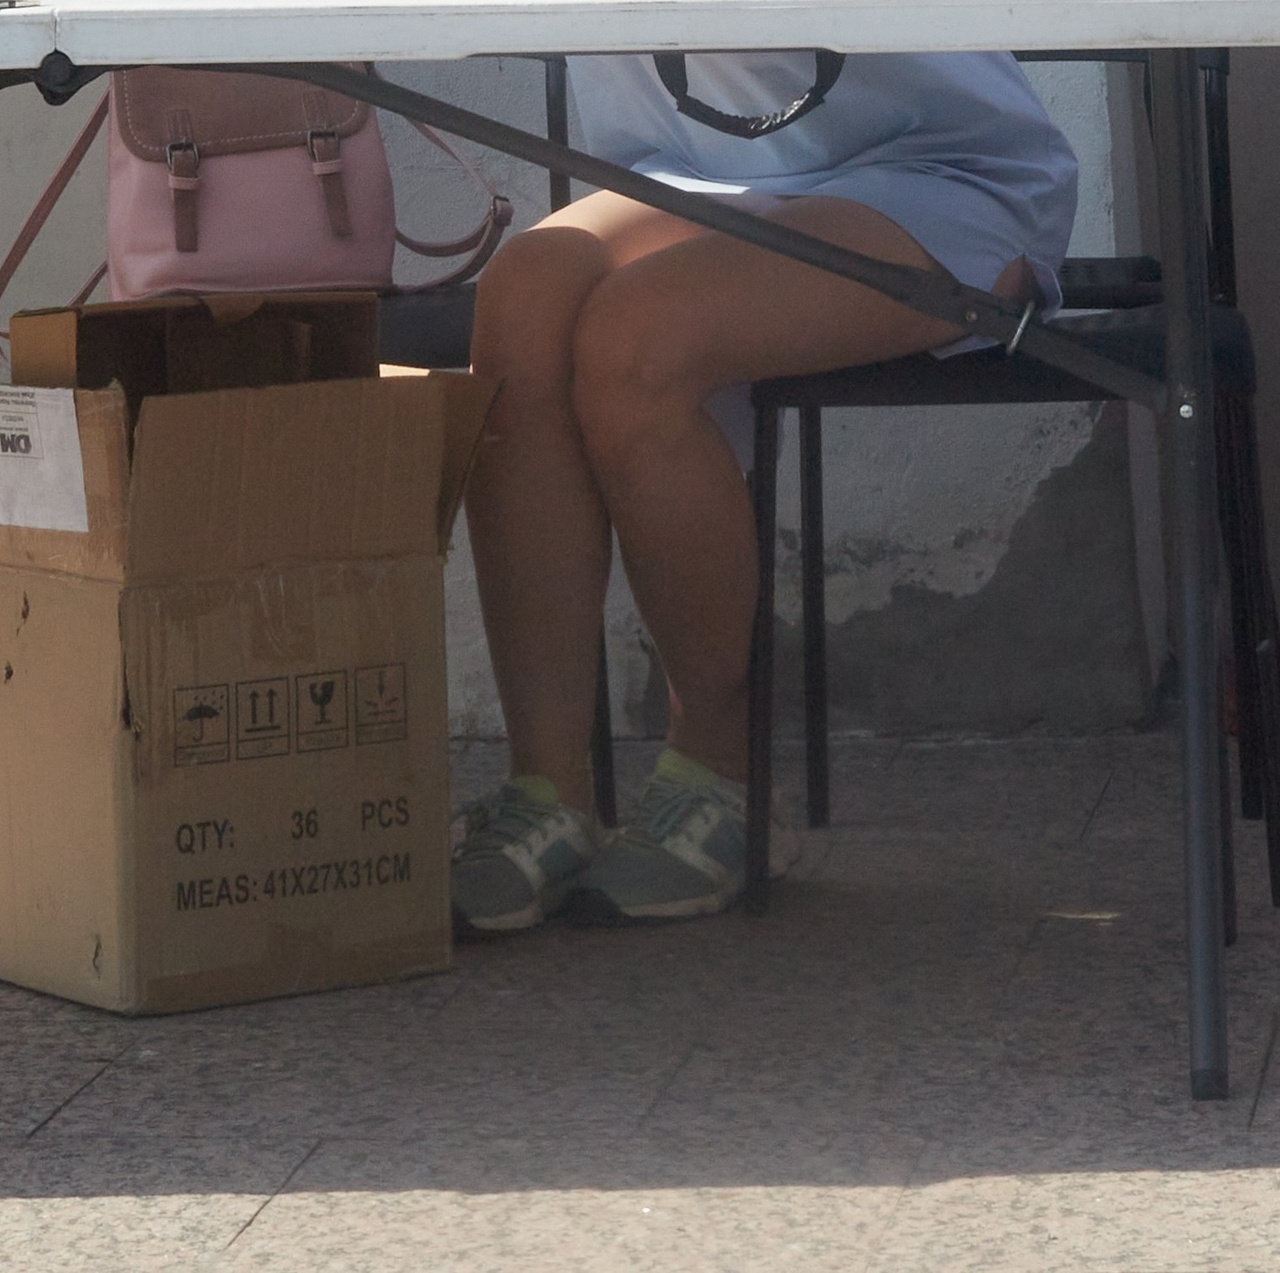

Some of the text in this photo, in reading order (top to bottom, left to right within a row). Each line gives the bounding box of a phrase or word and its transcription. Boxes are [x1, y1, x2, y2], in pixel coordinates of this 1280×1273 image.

[176, 796, 410, 855] QTY: 36 PCS
